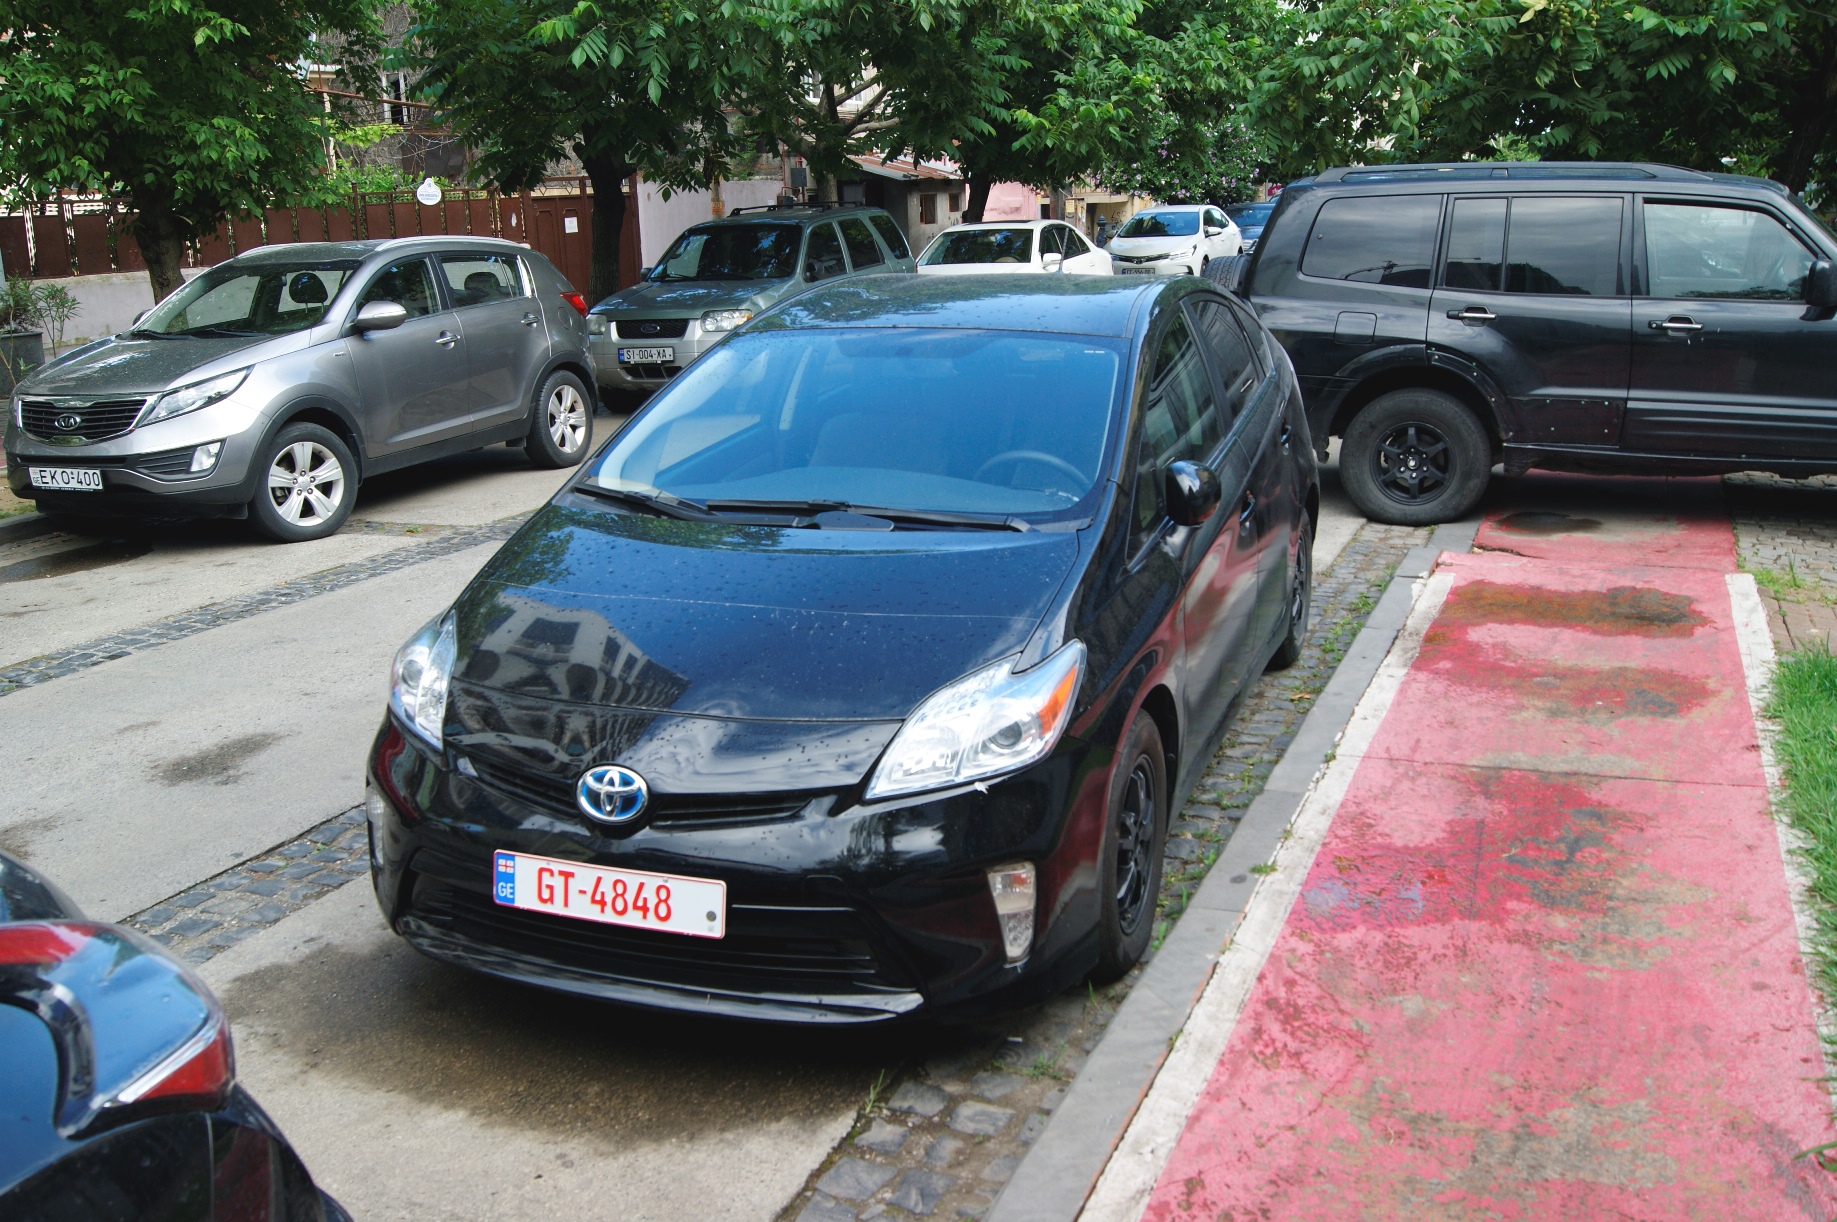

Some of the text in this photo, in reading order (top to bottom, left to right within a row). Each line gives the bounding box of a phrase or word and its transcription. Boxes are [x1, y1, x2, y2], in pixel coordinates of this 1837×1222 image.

[626, 349, 667, 360] SI-004-XA
[497, 866, 673, 923] GE GT-4848
